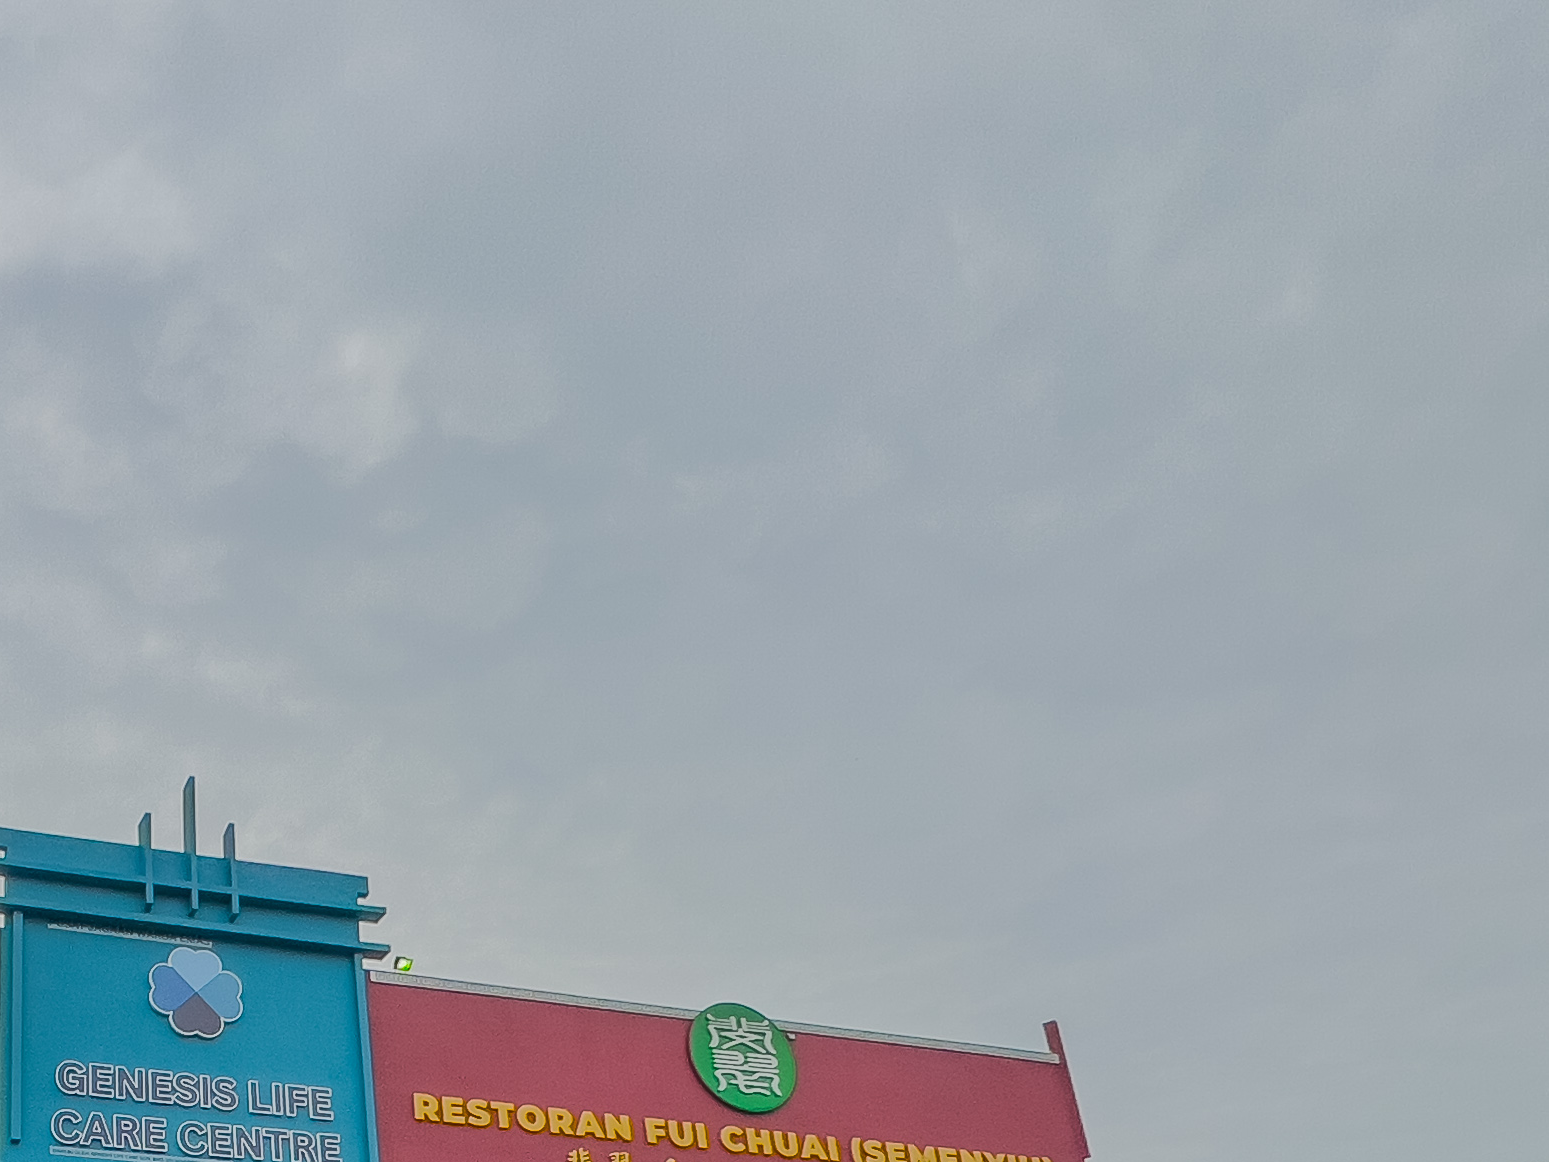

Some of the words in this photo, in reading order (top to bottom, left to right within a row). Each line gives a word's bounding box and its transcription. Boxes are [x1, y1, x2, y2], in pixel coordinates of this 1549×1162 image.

[54, 1059, 239, 1111] GENESIS
[247, 1079, 335, 1121] LIFE
[50, 1108, 169, 1153] CARE
[412, 1092, 634, 1142] RESTORAN
[643, 1117, 710, 1150] FUI
[720, 1125, 841, 1162] CHUAI
